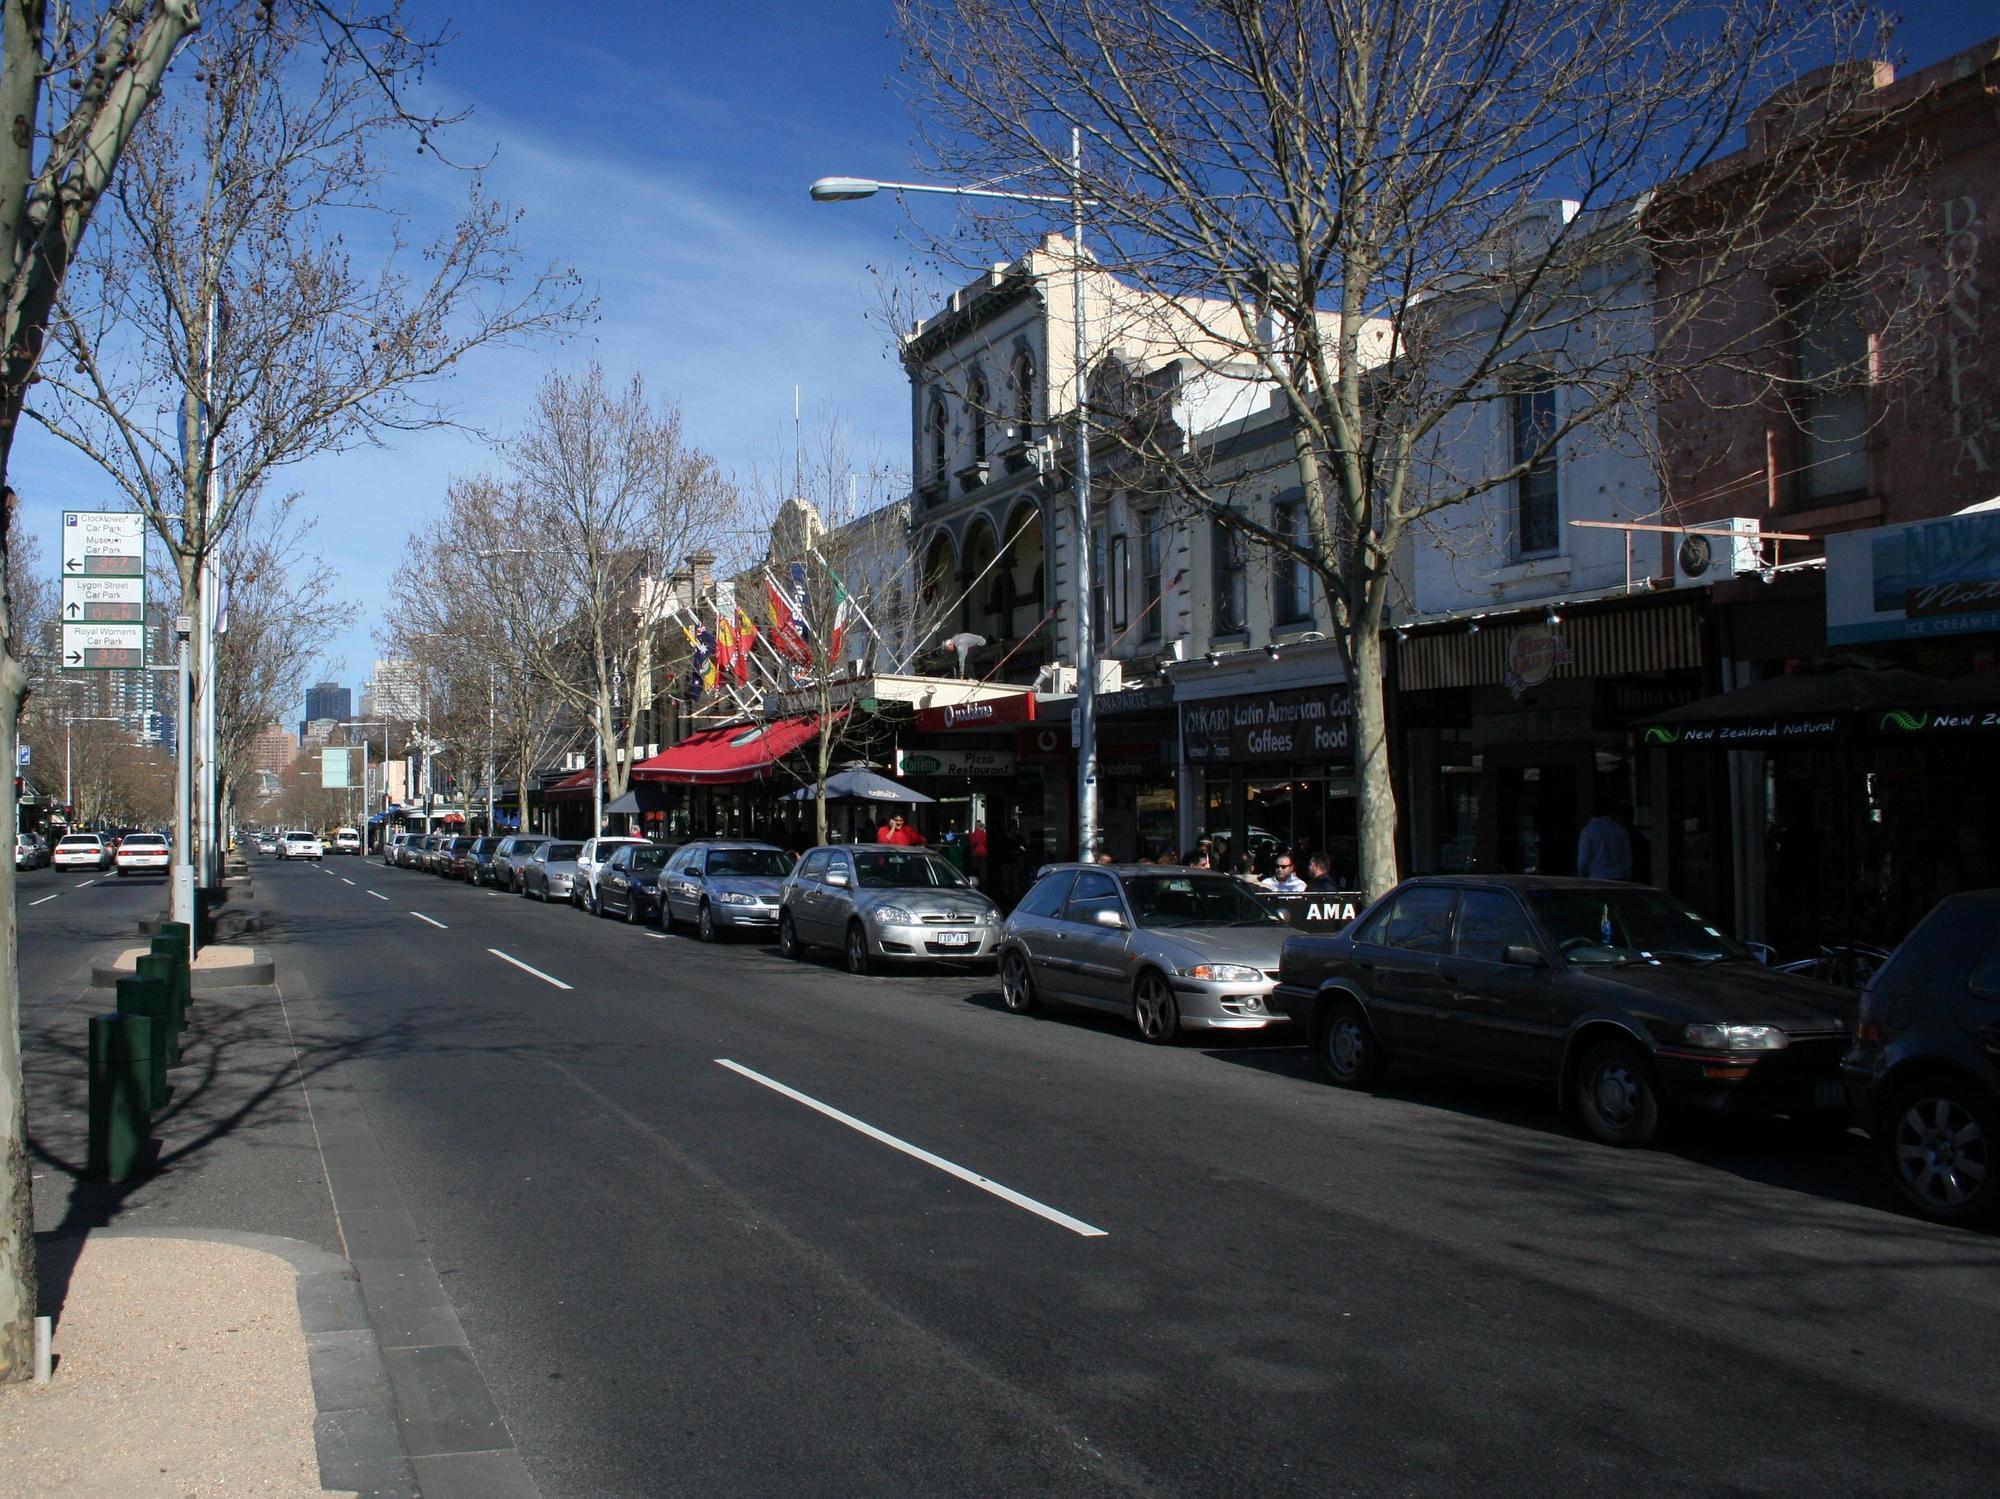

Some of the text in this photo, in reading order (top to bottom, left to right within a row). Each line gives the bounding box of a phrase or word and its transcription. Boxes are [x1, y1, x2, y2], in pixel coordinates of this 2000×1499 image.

[81, 514, 127, 524] Clocktower
[86, 524, 122, 533] Car Park
[86, 536, 122, 544] Museum
[86, 546, 122, 554] Car Park
[77, 581, 129, 591] Lygon Street
[85, 591, 122, 599] Car Park
[74, 627, 136, 637] Royal Womens
[1905, 621, 1926, 634] ICE
[87, 637, 122, 646] Car Park
[1095, 693, 1148, 713] ONAPARTE
[1234, 702, 1264, 725] Latin
[1267, 696, 1325, 722] American
[1933, 714, 1975, 727] New
[1684, 719, 1835, 741] New Zealand Natural
[1248, 728, 1293, 753] Coffees
[1315, 722, 1348, 749] Food
[964, 752, 994, 764] Pizza
[948, 763, 1009, 775] Restaurant
[1306, 903, 1356, 920] AMA
